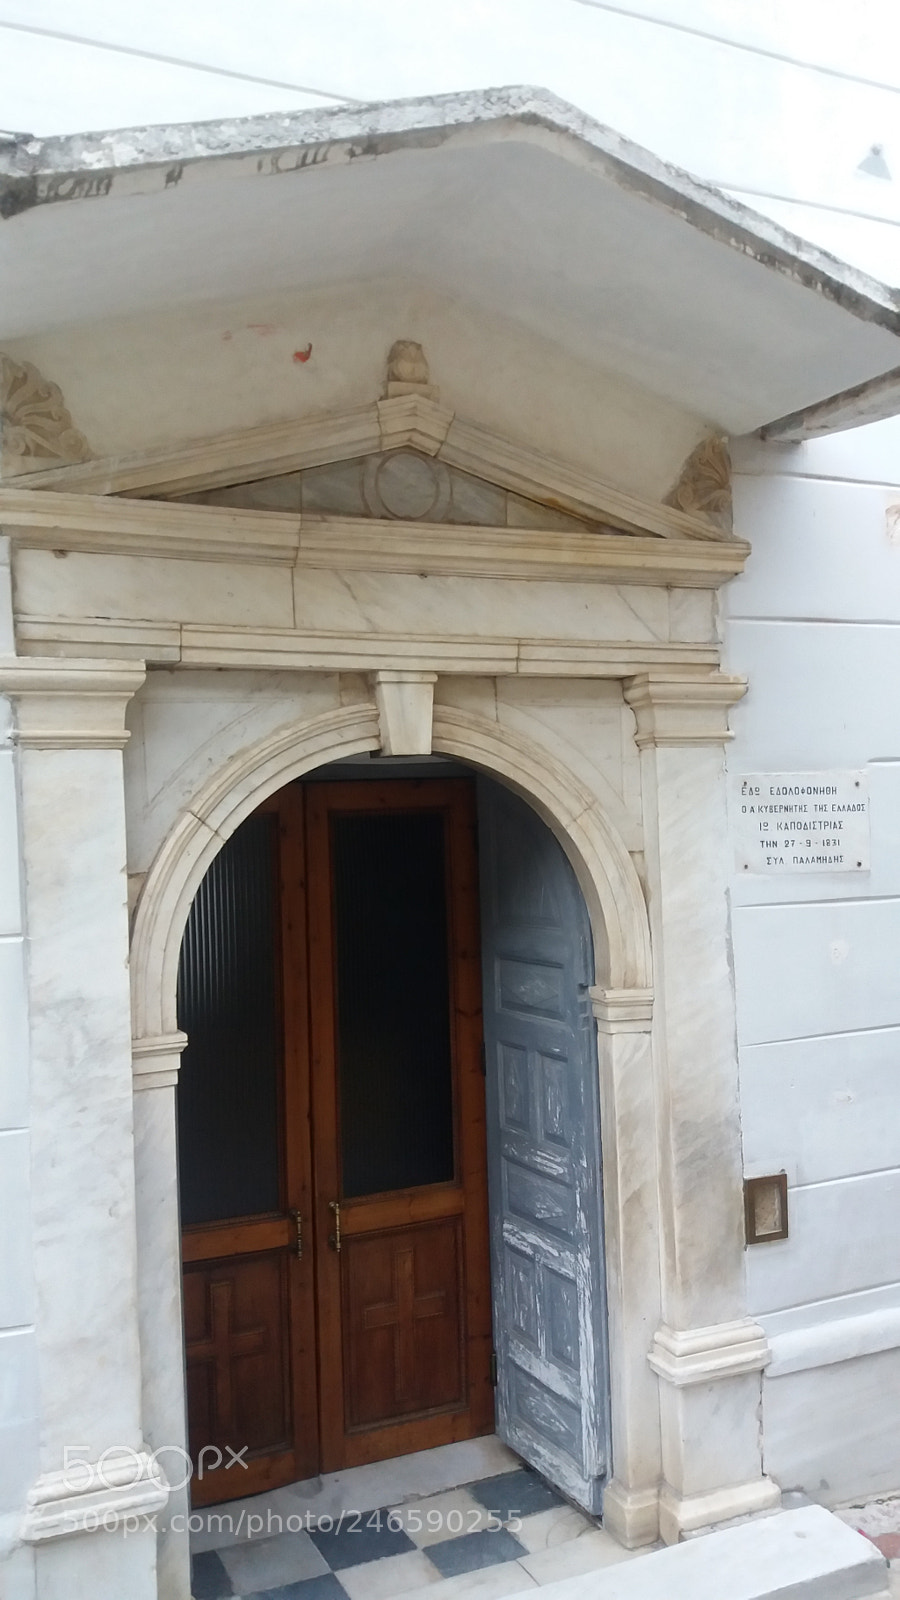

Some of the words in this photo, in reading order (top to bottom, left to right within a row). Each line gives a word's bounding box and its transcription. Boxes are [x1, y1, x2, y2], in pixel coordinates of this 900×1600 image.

[741, 786, 760, 796] ΕΔΩ
[769, 786, 837, 796] ΕΔΟΛΟΦΟΝΗΘΗ
[758, 804, 808, 813] ΚΥΒΕΡΝΗΤΗΣ
[814, 804, 828, 812] ΤΗΣ
[831, 803, 866, 812] ΕΛΛΑΔΟΣ
[776, 820, 844, 831] ΚΑΠΟΔΙΣΤΡΙΑΣ
[760, 840, 778, 848] ΤΗΝ
[793, 855, 844, 864] ΠΑΛΑΜΗΔΗΣ
